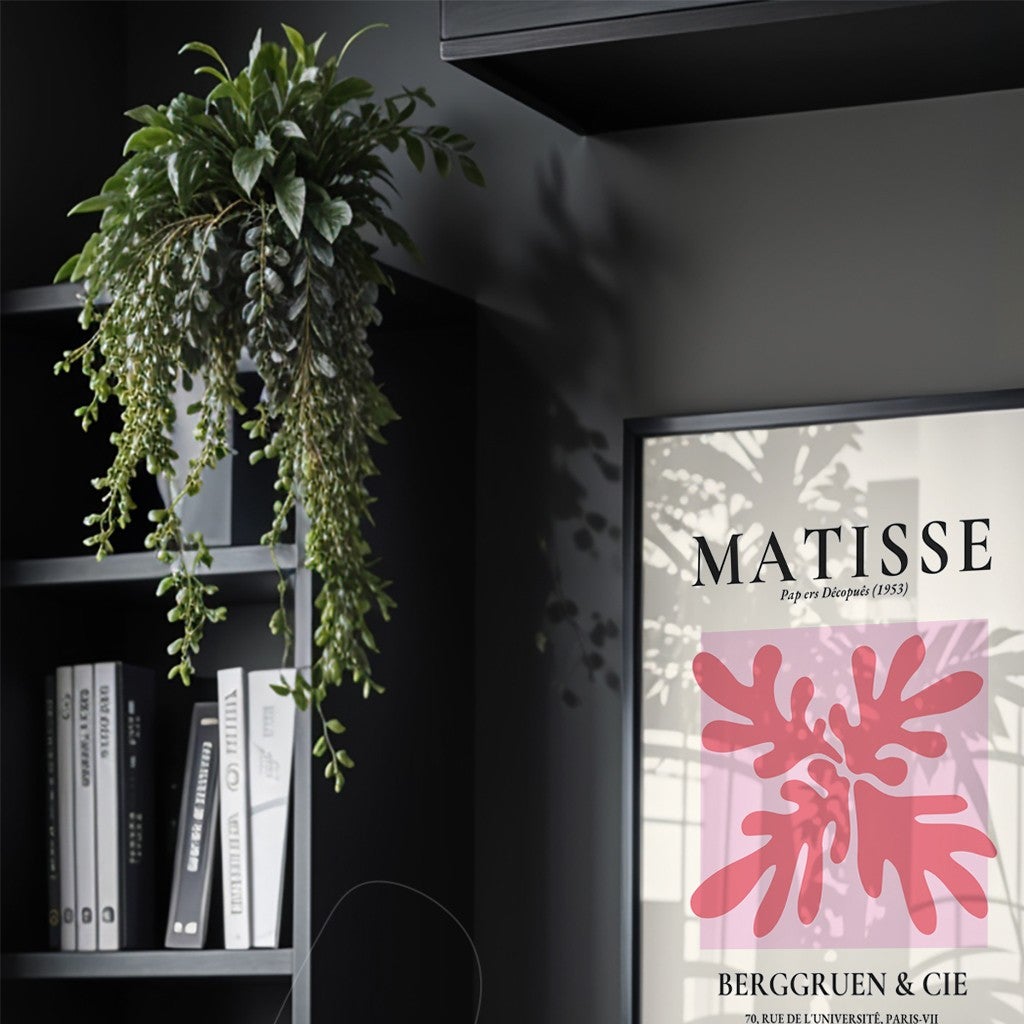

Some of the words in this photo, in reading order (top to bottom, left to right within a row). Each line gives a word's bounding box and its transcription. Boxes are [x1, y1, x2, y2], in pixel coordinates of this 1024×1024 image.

[692, 518, 993, 587] MATISSE
[872, 581, 909, 598] (1953)
[718, 971, 888, 997] BERGGRUEN
[895, 971, 916, 997] &
[922, 971, 968, 997] CIE
[762, 1013, 785, 1024] RUE
[787, 1013, 802, 1024] DE
[886, 1013, 939, 1024] PARIS-VII
